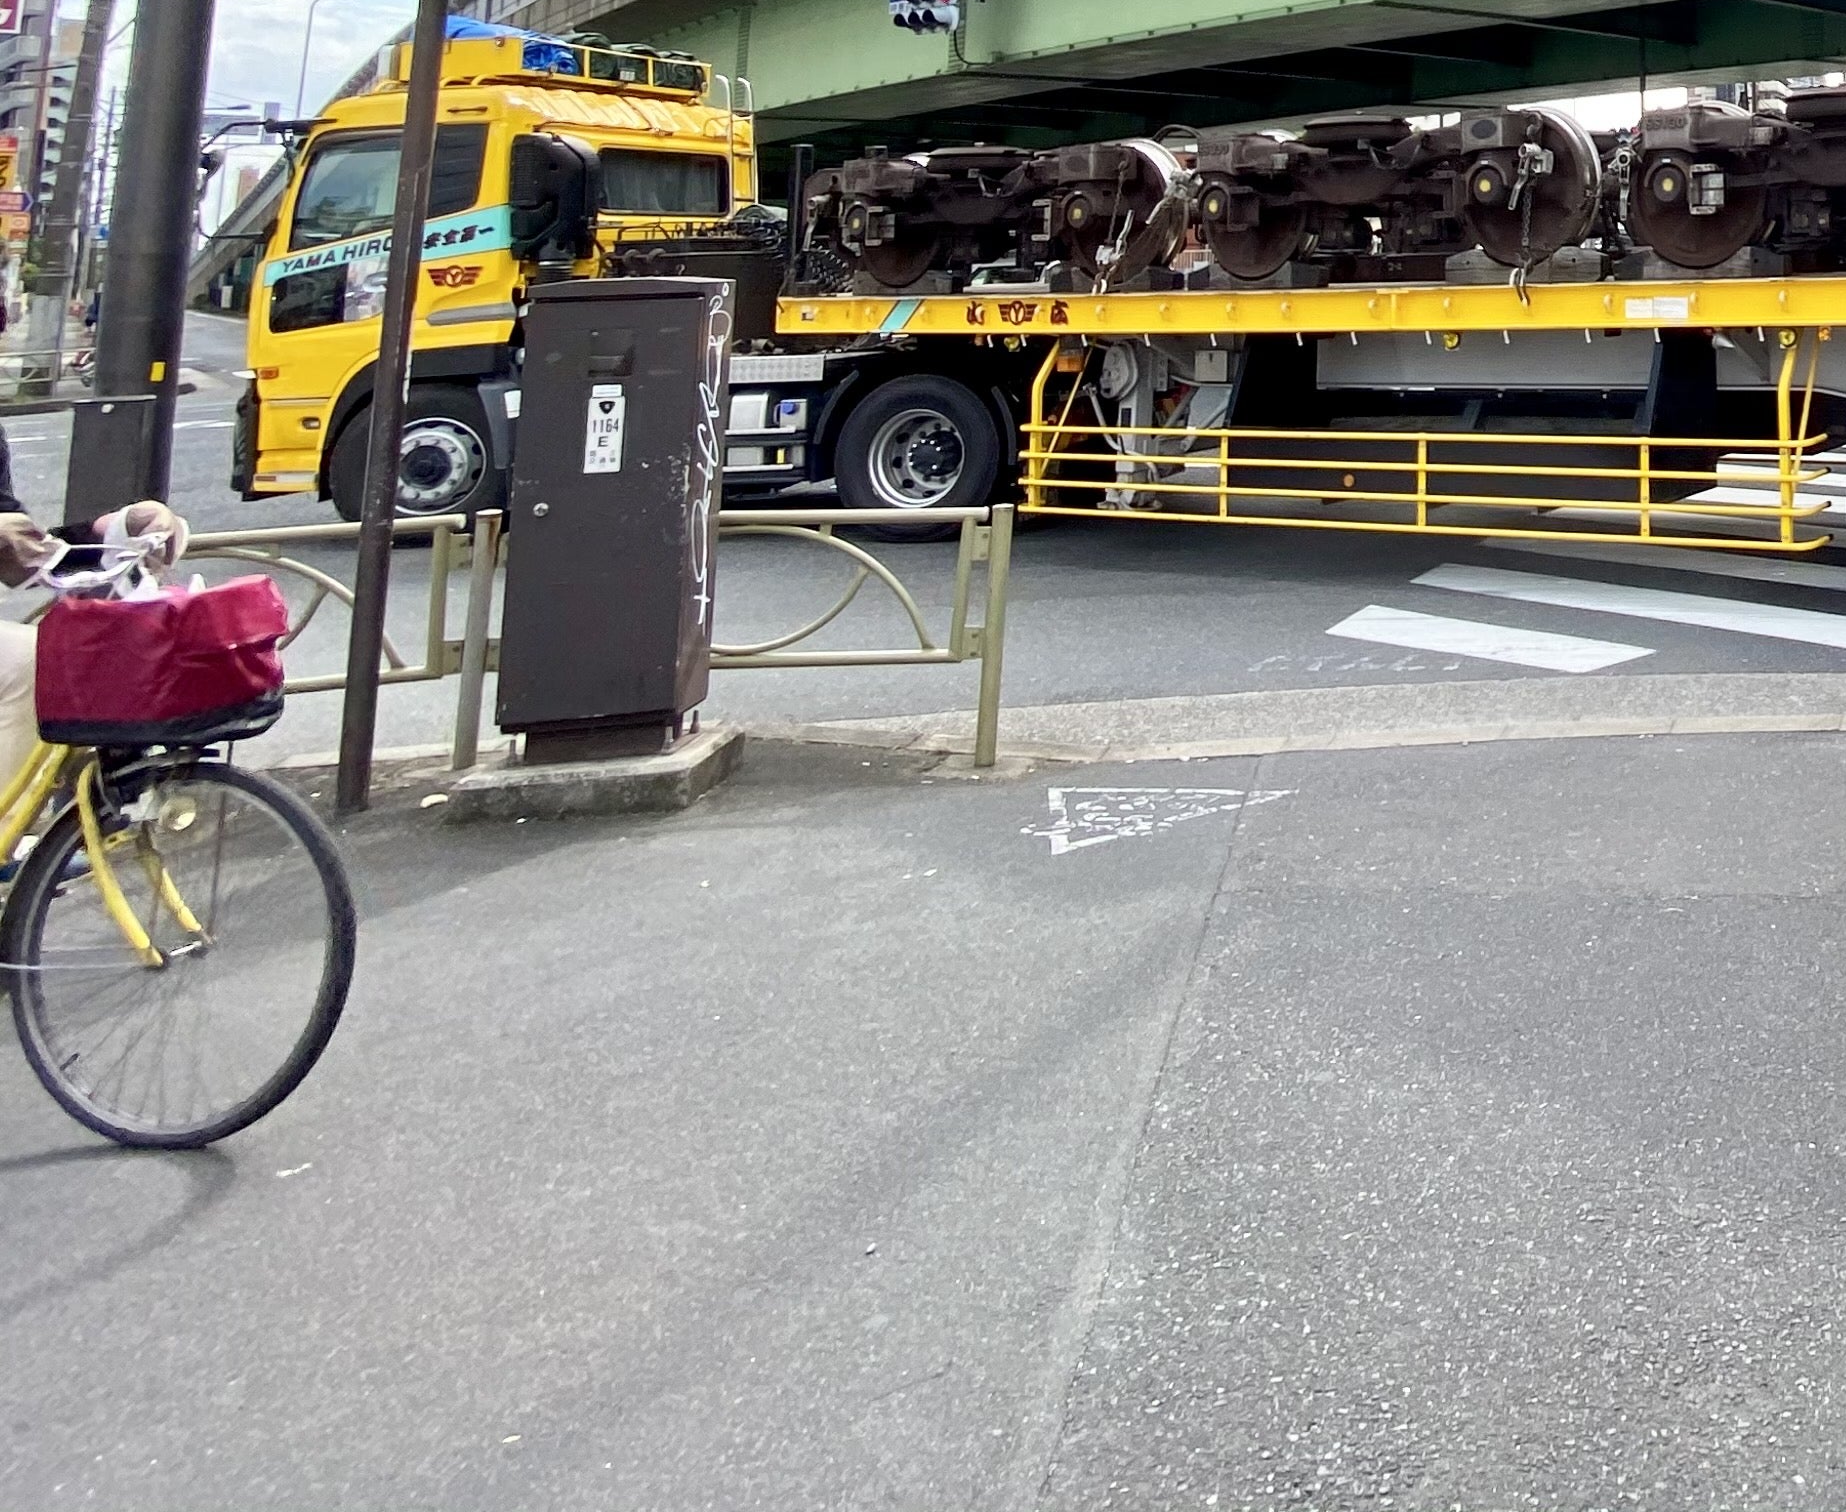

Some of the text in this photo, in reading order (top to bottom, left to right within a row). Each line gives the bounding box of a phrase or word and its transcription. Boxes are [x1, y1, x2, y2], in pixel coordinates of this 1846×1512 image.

[283, 250, 336, 273] YAMA
[592, 418, 619, 433] 1164
[597, 436, 609, 447] E
